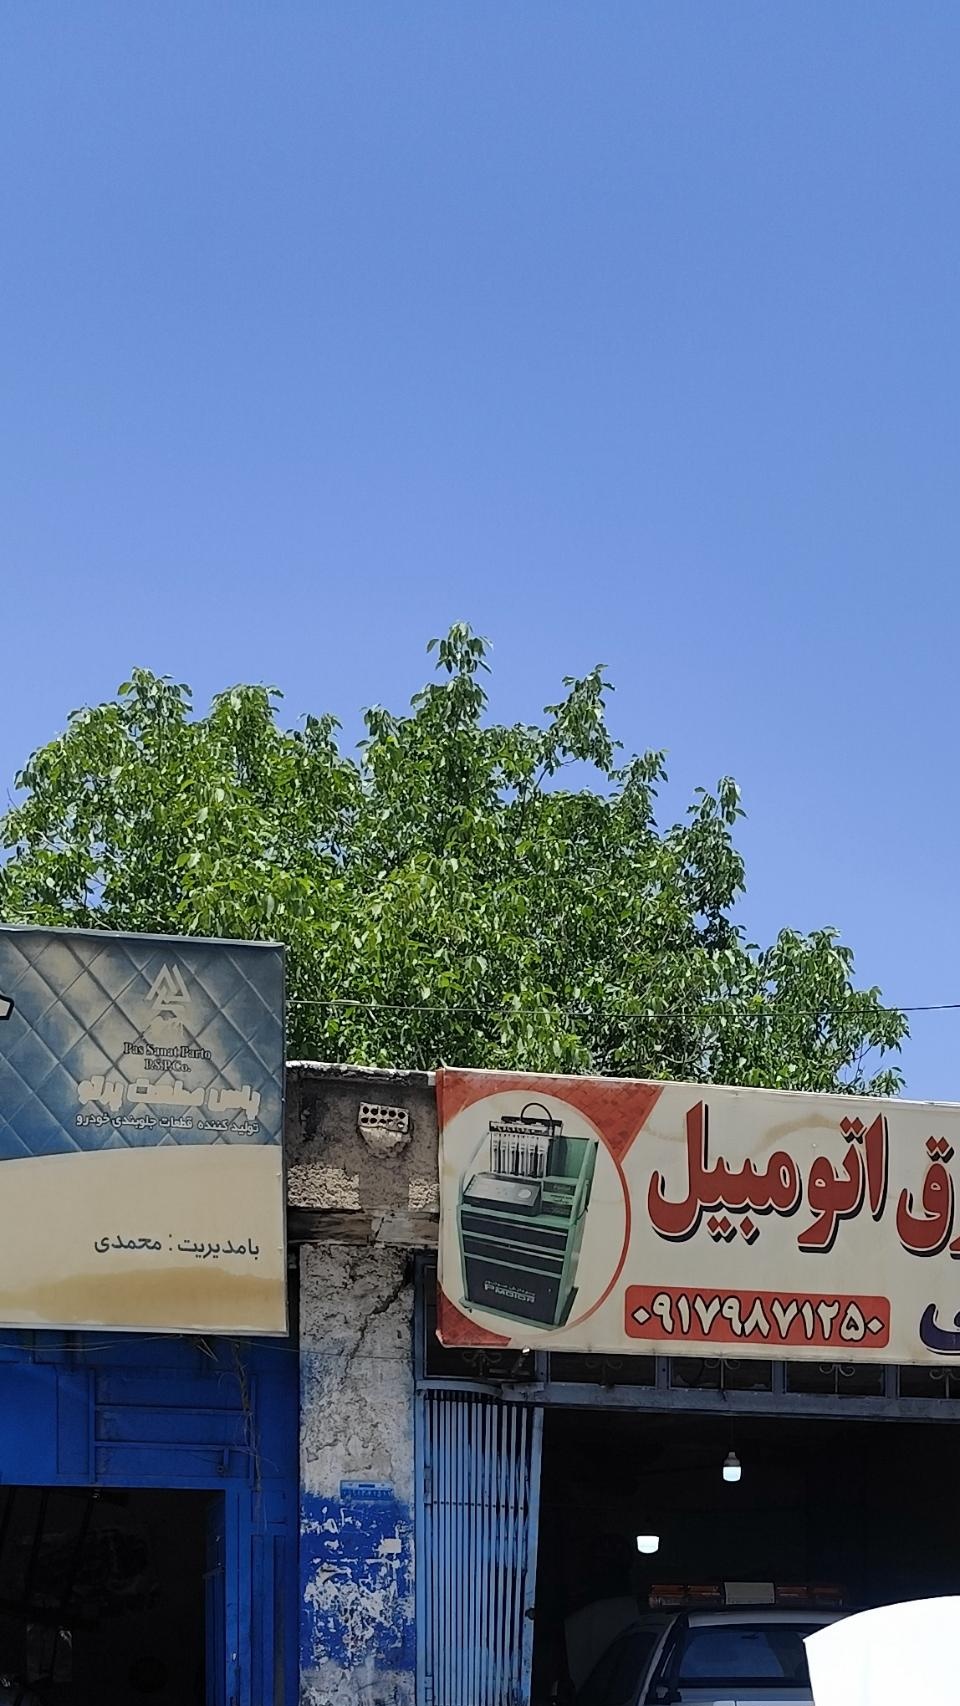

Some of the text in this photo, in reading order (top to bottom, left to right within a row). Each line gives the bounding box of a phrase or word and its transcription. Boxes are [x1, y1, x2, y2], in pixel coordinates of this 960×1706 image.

[123, 1041, 212, 1060] Pas Sanat Parto
[75, 1112, 260, 1135] تولید کننده قطعات جلوبندی خودرو
[647, 1099, 889, 1253] اتومبیل
[94, 1235, 162, 1253] محمدی
[631, 1291, 885, 1342] ۰۹۱۷۹۸۷۱۲۵۰
